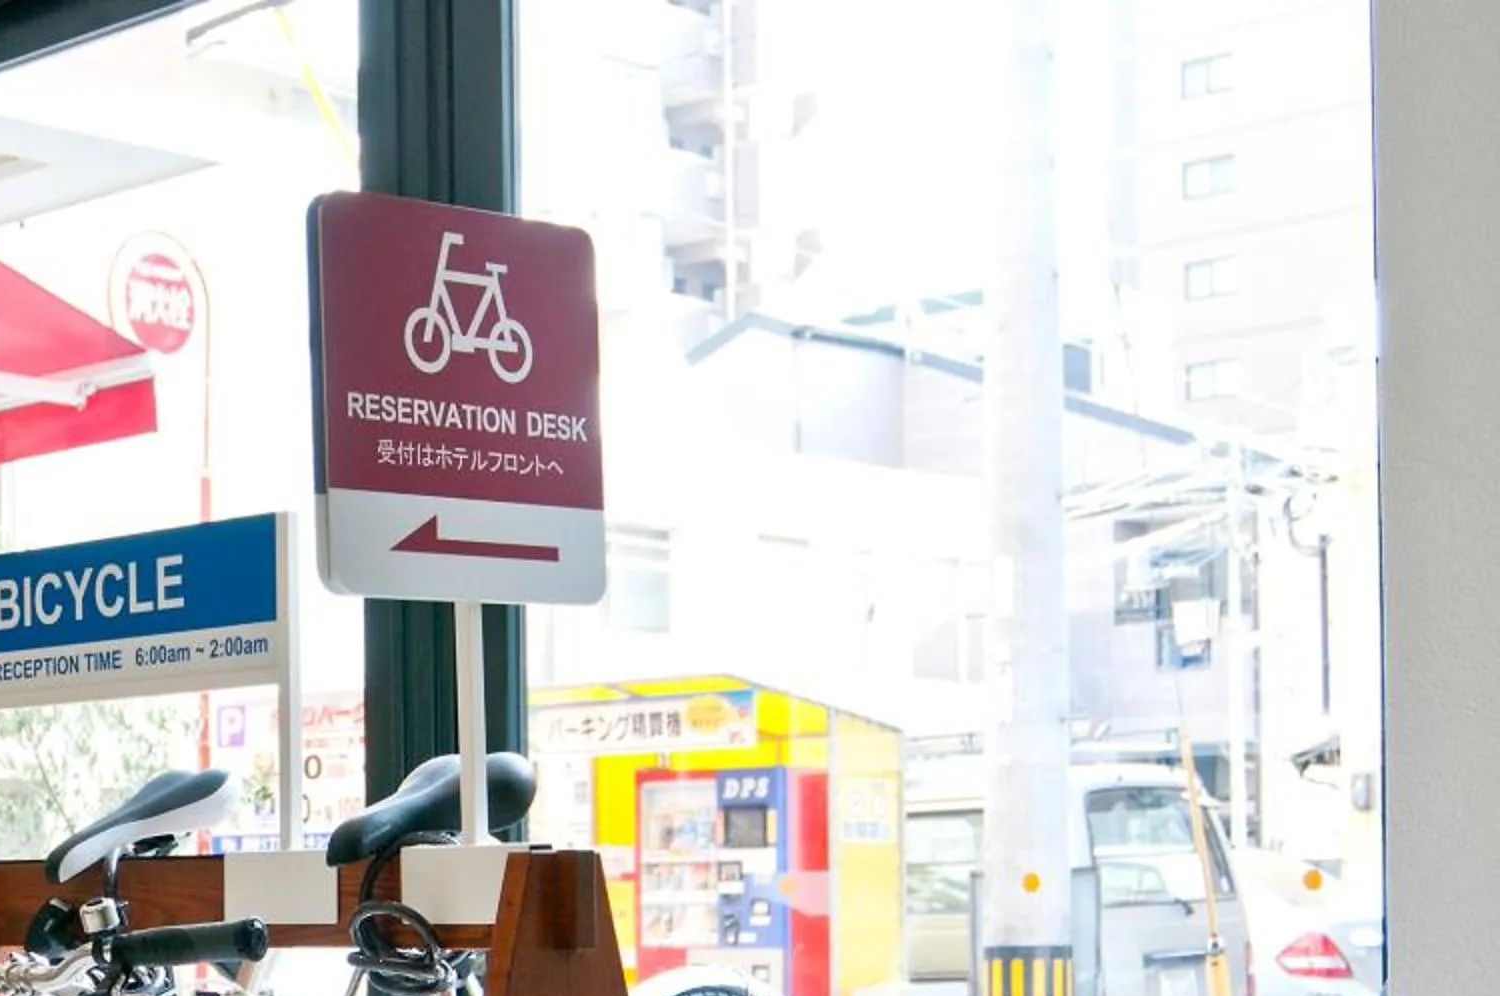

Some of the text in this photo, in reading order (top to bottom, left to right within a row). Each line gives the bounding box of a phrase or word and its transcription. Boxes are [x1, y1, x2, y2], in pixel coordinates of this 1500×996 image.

[347, 391, 588, 443] RESERVATION DESK
[376, 439, 565, 477] 受付はホテルフロントへ
[84, 650, 123, 673] TIME
[135, 644, 191, 667] 6:00am
[209, 636, 269, 659] 2:00am
